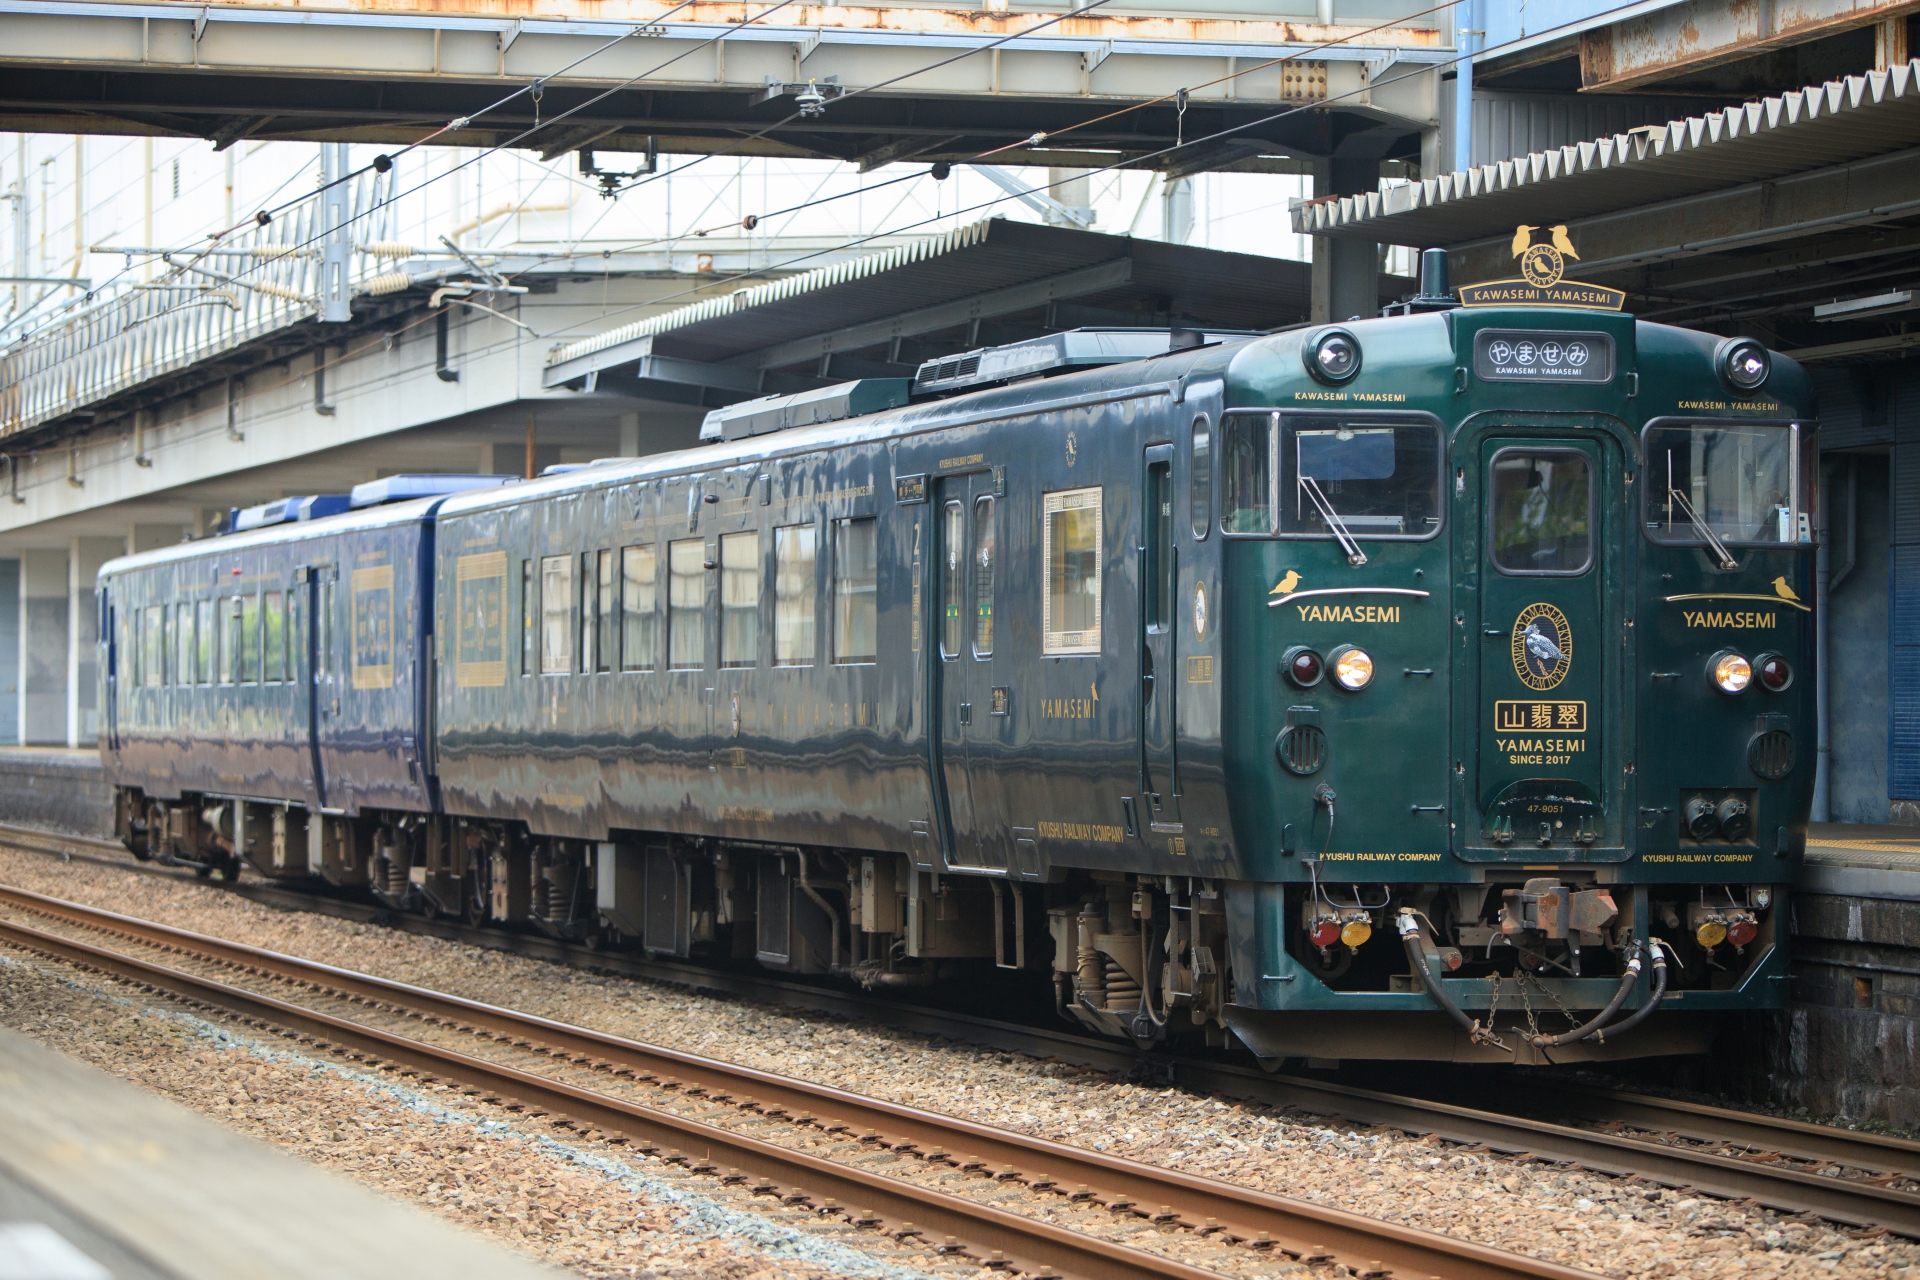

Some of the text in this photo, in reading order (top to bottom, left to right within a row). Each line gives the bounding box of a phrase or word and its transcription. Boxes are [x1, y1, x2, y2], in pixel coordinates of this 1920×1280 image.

[1525, 246, 1560, 263] KAWASEMI
[1474, 289, 1611, 304] KAWASEMI YAMASEMI
[1491, 343, 1586, 364] やませみ
[1496, 367, 1582, 376] KAWASEMI YAMASEMI
[1295, 392, 1407, 402] KAWASEMI YAMASEMI
[1678, 401, 1778, 411] KAWASEMI YAMASEMI
[914, 522, 920, 555] 2
[1297, 605, 1400, 623] YAMASEMI
[1683, 611, 1776, 628] YAMASEMI
[768, 703, 880, 726] YAMASEMI
[1040, 698, 1096, 719] YAMASEMI
[1504, 704, 1578, 729] 山翡翠
[1496, 739, 1585, 752] YAMASEMI
[1510, 755, 1570, 765] SINCE 2017
[1527, 804, 1564, 813] 47-9051
[1038, 821, 1124, 843] KYUSHU RAILWAY COMPANY
[1319, 852, 1441, 862] KYUSHU RAILWAY COMPANY
[1642, 854, 1753, 863] KYUSHU RAILWAY COMPANY
